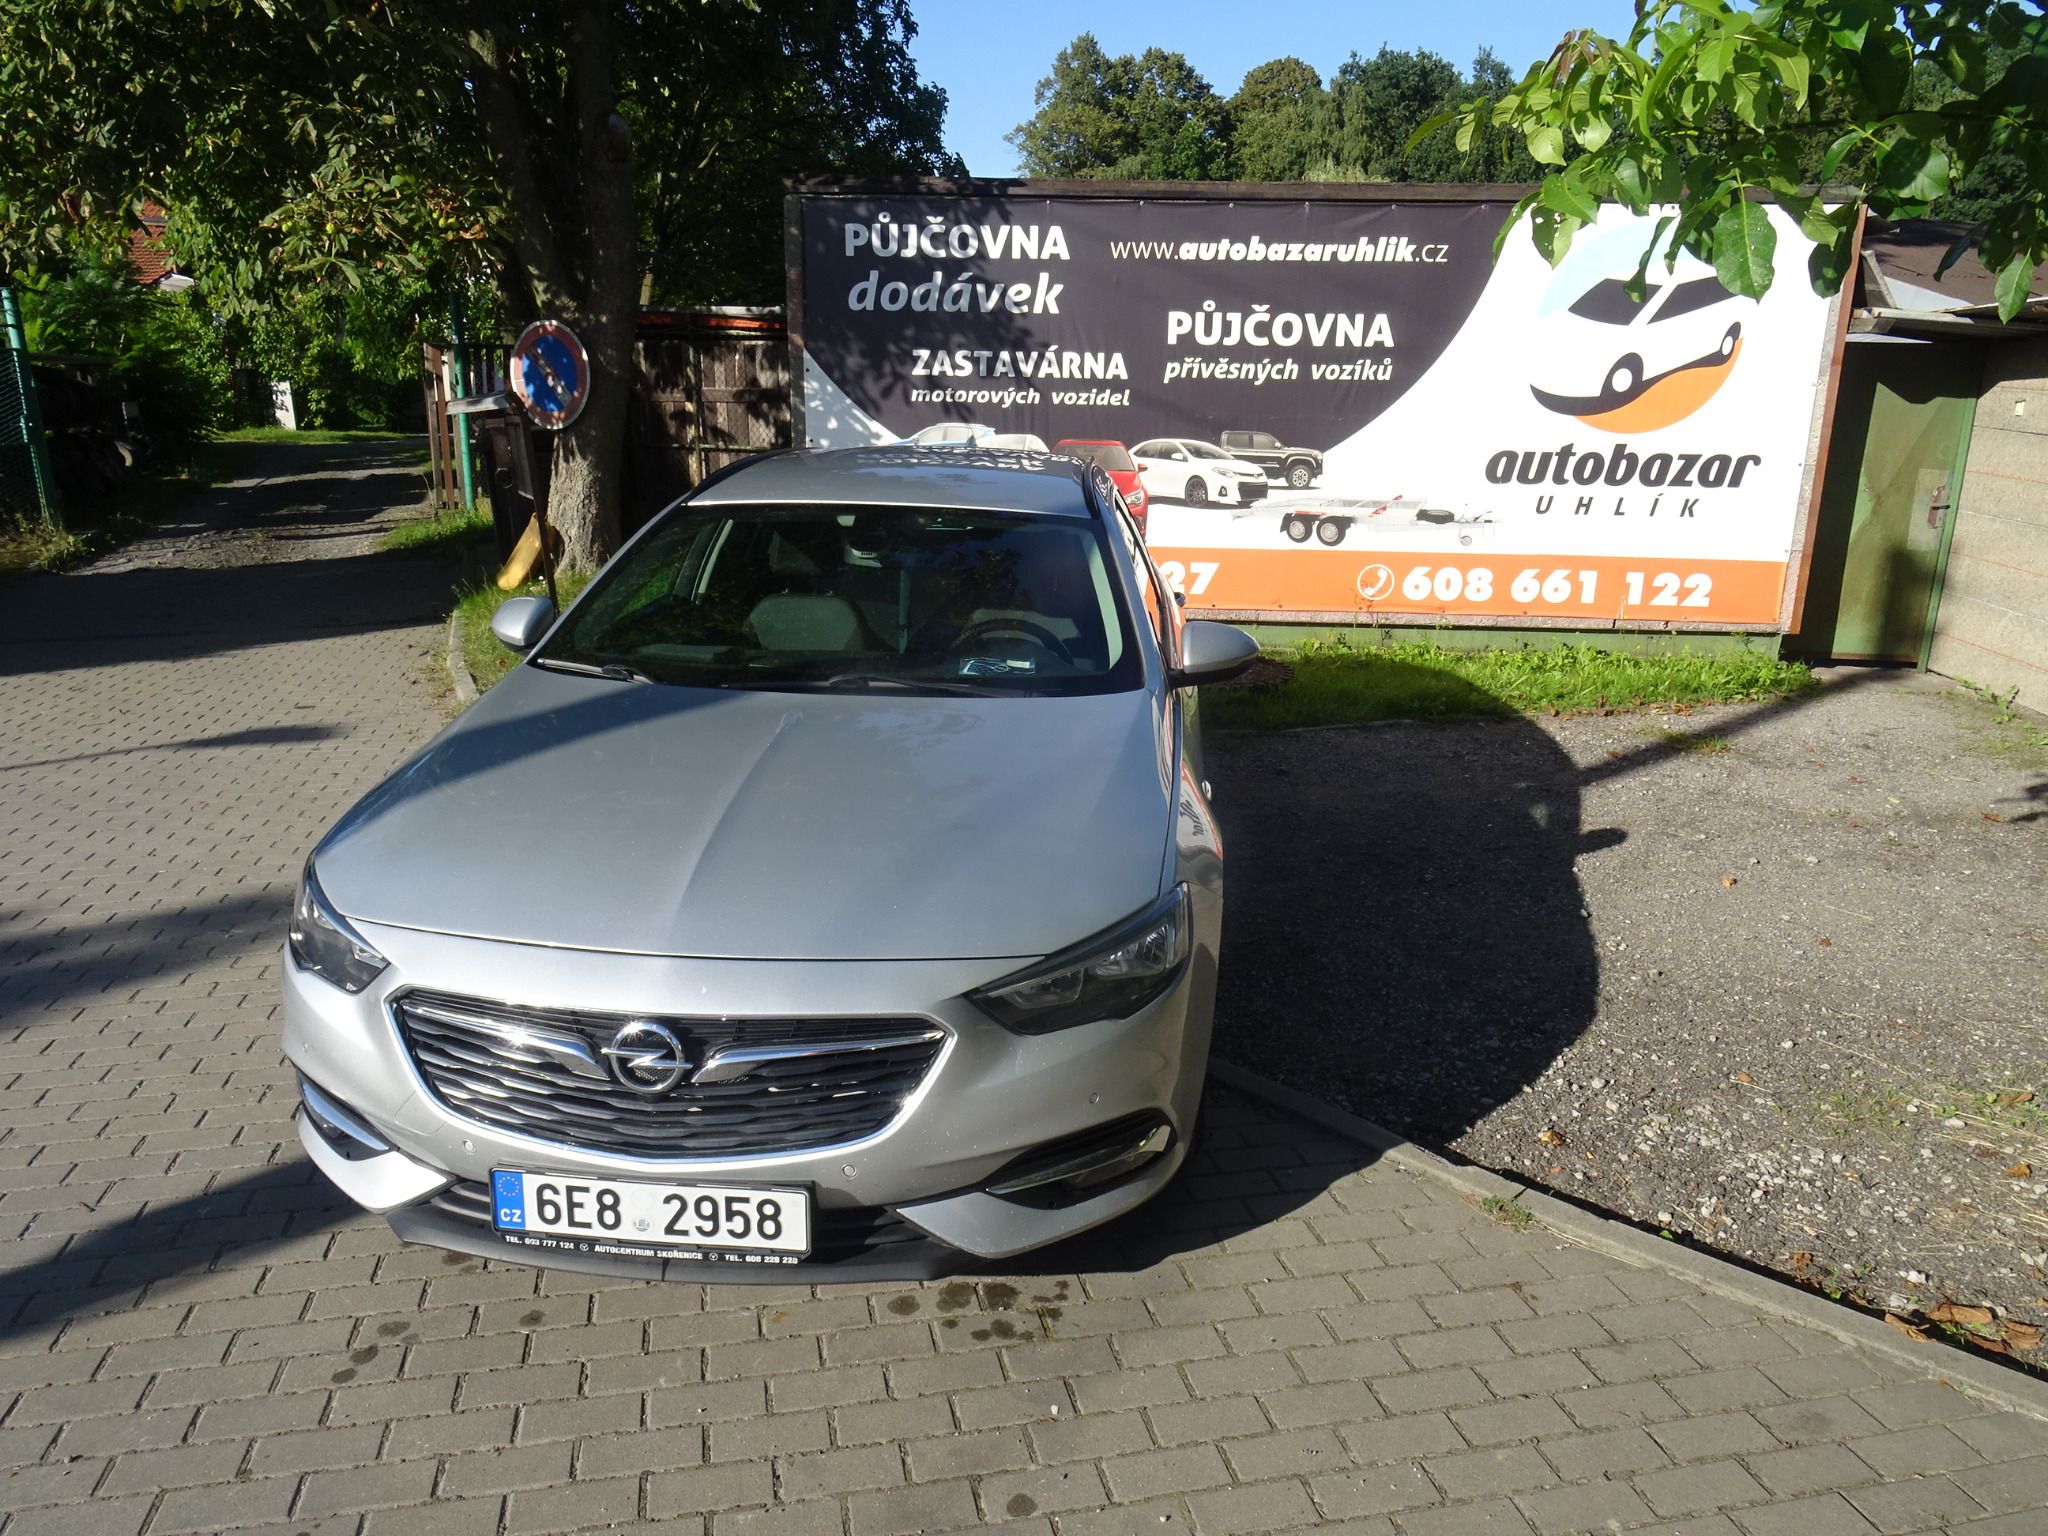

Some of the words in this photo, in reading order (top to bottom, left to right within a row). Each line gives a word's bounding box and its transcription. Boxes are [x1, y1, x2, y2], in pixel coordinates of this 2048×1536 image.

[844, 211, 1070, 260] PŮJČOVNA
[1110, 236, 1448, 263] www.autobazaruhlik.cz
[848, 270, 1064, 314] dodávek
[1167, 300, 1395, 347] PŮJČOVNA
[911, 345, 1129, 380] ZASTAVÁRNA
[1163, 357, 1299, 385] přívěsných
[1311, 357, 1393, 381] vozíků
[911, 387, 1040, 408] motorových
[1051, 389, 1130, 406] vozidel
[1485, 442, 1762, 488] autobazar
[1158, 560, 1220, 595] 27
[1402, 566, 1494, 602] 608
[1510, 568, 1599, 605] 661
[1624, 571, 1713, 608] 122
[500, 1209, 522, 1223] CZ
[536, 1183, 622, 1231] 6E8
[662, 1193, 782, 1241] 2958
[505, 1235, 522, 1244] TEL.
[542, 1239, 557, 1248] 777
[559, 1241, 575, 1250] 124
[594, 1245, 655, 1257] AUTOCENTRUM
[725, 1254, 743, 1262] TEL.
